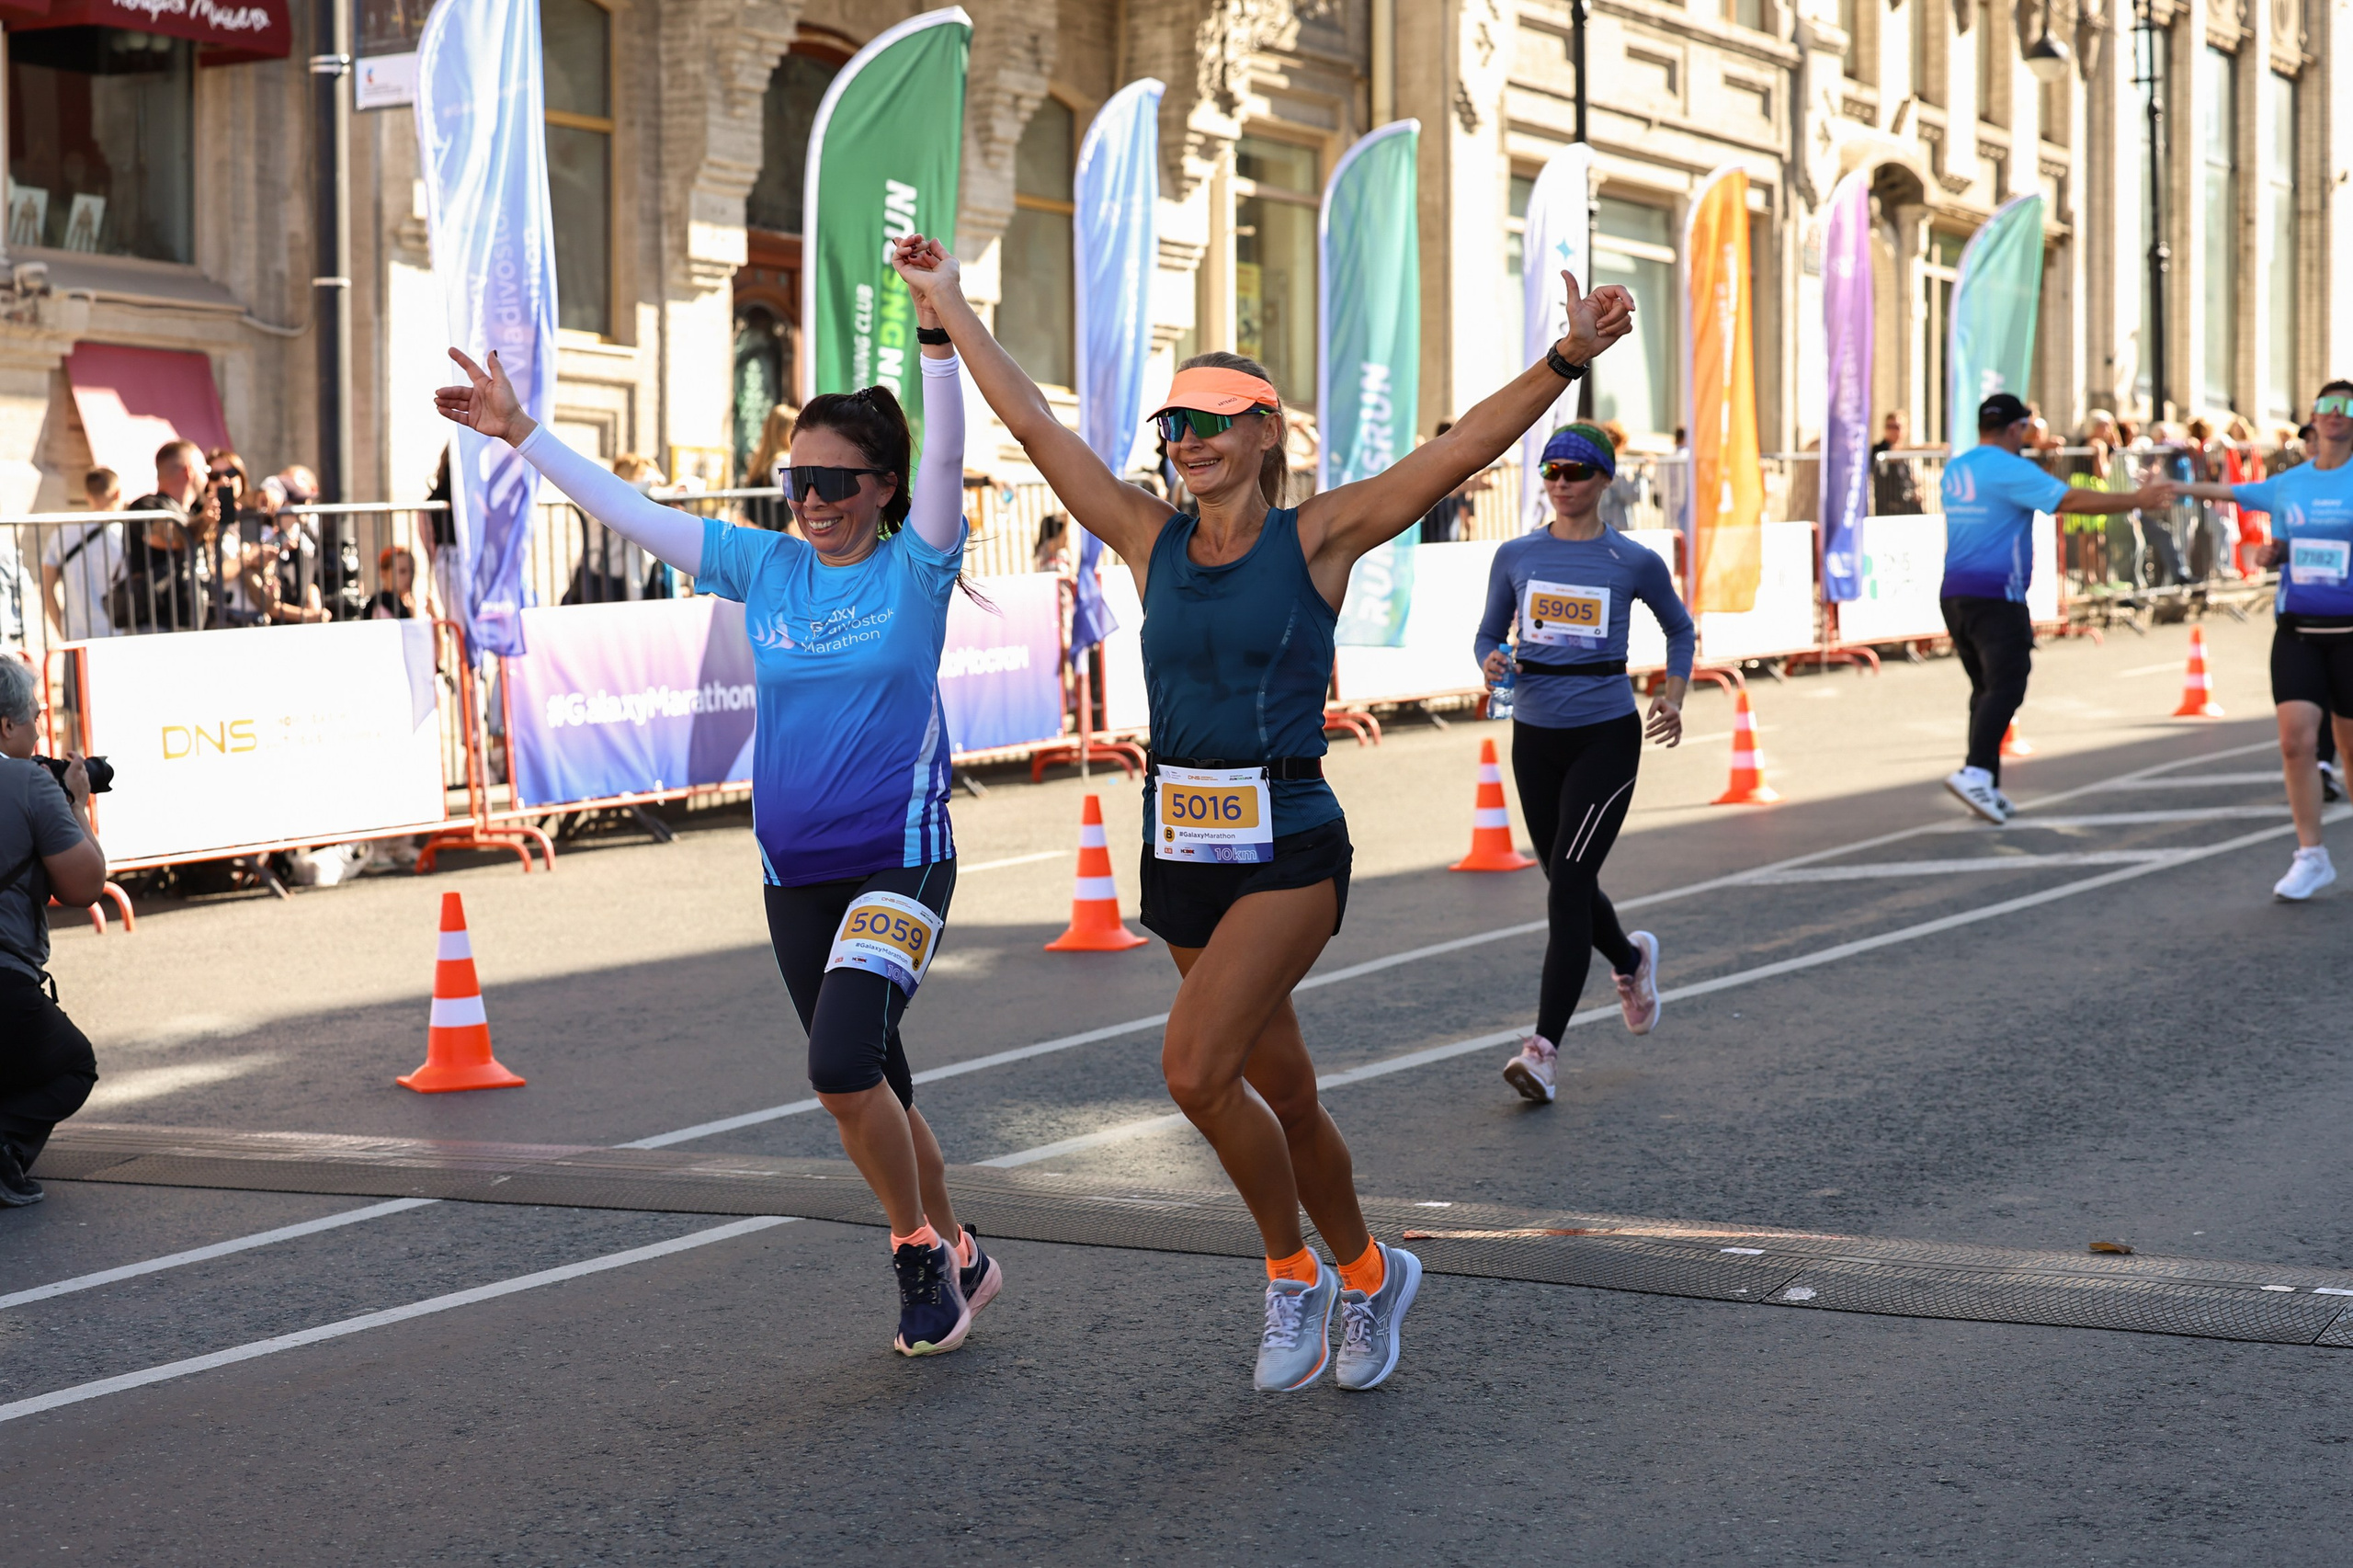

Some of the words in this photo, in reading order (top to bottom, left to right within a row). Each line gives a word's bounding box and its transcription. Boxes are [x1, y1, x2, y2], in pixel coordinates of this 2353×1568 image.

[493, 202, 527, 377] Vladivosto
[877, 178, 918, 397] UNDNSUN
[854, 283, 874, 334] CLUB
[810, 606, 856, 632] Gaxy
[1538, 598, 1593, 620] 5905
[801, 630, 881, 653] Marathon
[546, 679, 756, 729] #GalaxyMarathon
[162, 719, 257, 760] DNS
[1172, 793, 1242, 821] 5016
[1165, 829, 1173, 839] B
[1179, 831, 1236, 839] #GalaxyMarathon
[1214, 847, 1257, 860] 10km
[850, 912, 923, 951] 5059
[855, 942, 908, 964] #GalaxyMarathon
